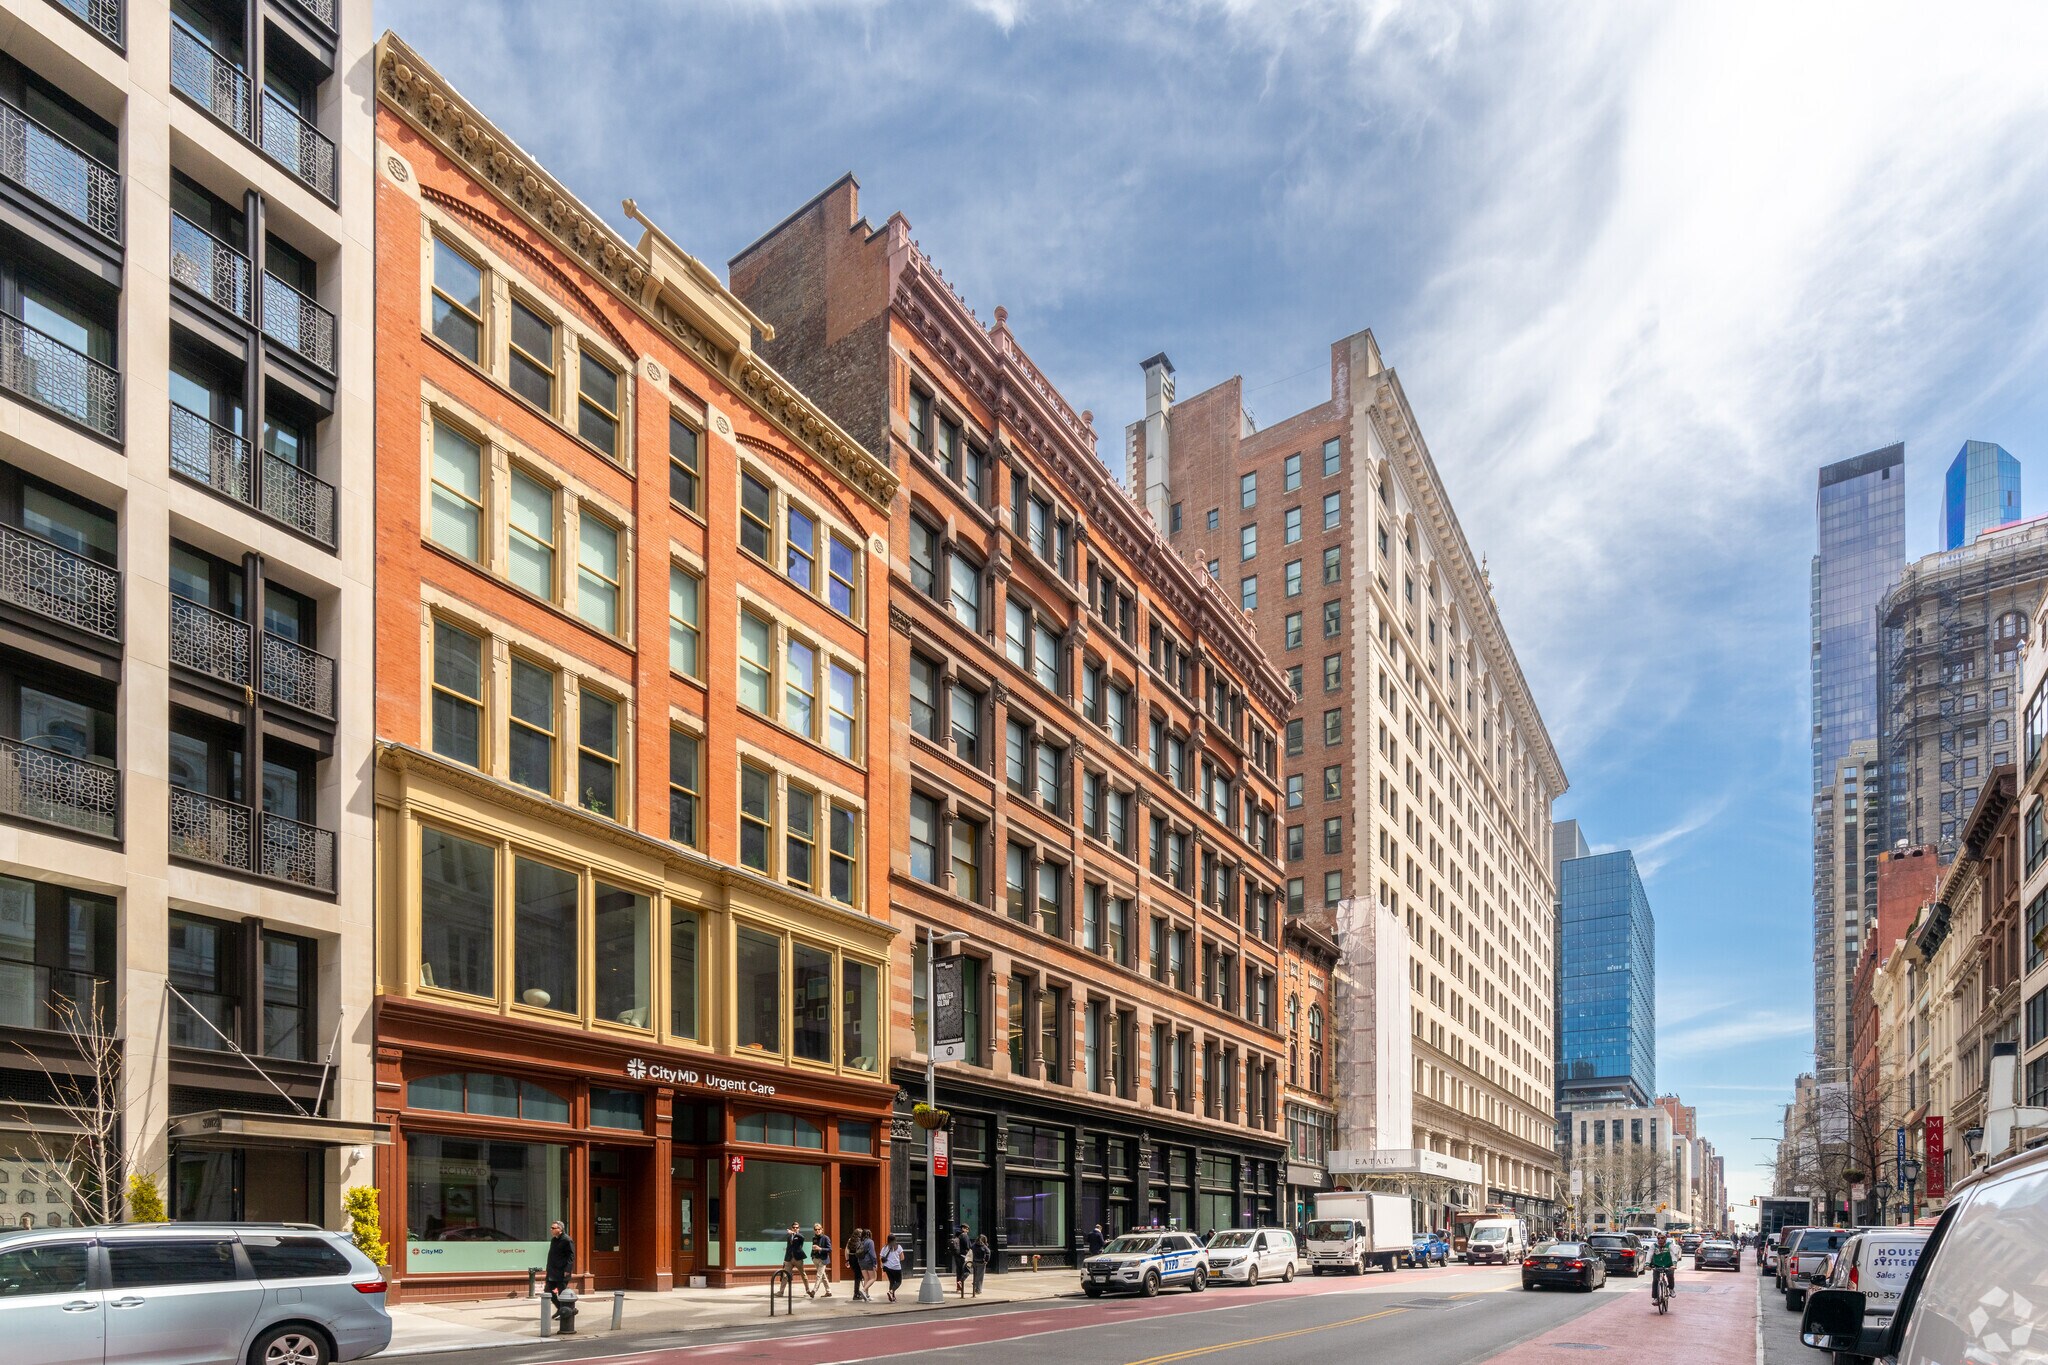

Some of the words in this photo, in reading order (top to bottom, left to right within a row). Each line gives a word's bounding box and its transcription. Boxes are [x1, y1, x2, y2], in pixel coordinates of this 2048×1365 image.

[662, 305, 719, 367] 1879
[649, 1065, 699, 1083] CityMD
[705, 1074, 746, 1091] Urgent
[748, 1080, 775, 1095] Care
[1355, 1157, 1396, 1165] EATALY
[1878, 1248, 1920, 1256] HOUSE
[1164, 1259, 1179, 1271] NYPD
[1876, 1271, 1896, 1279] Sales
